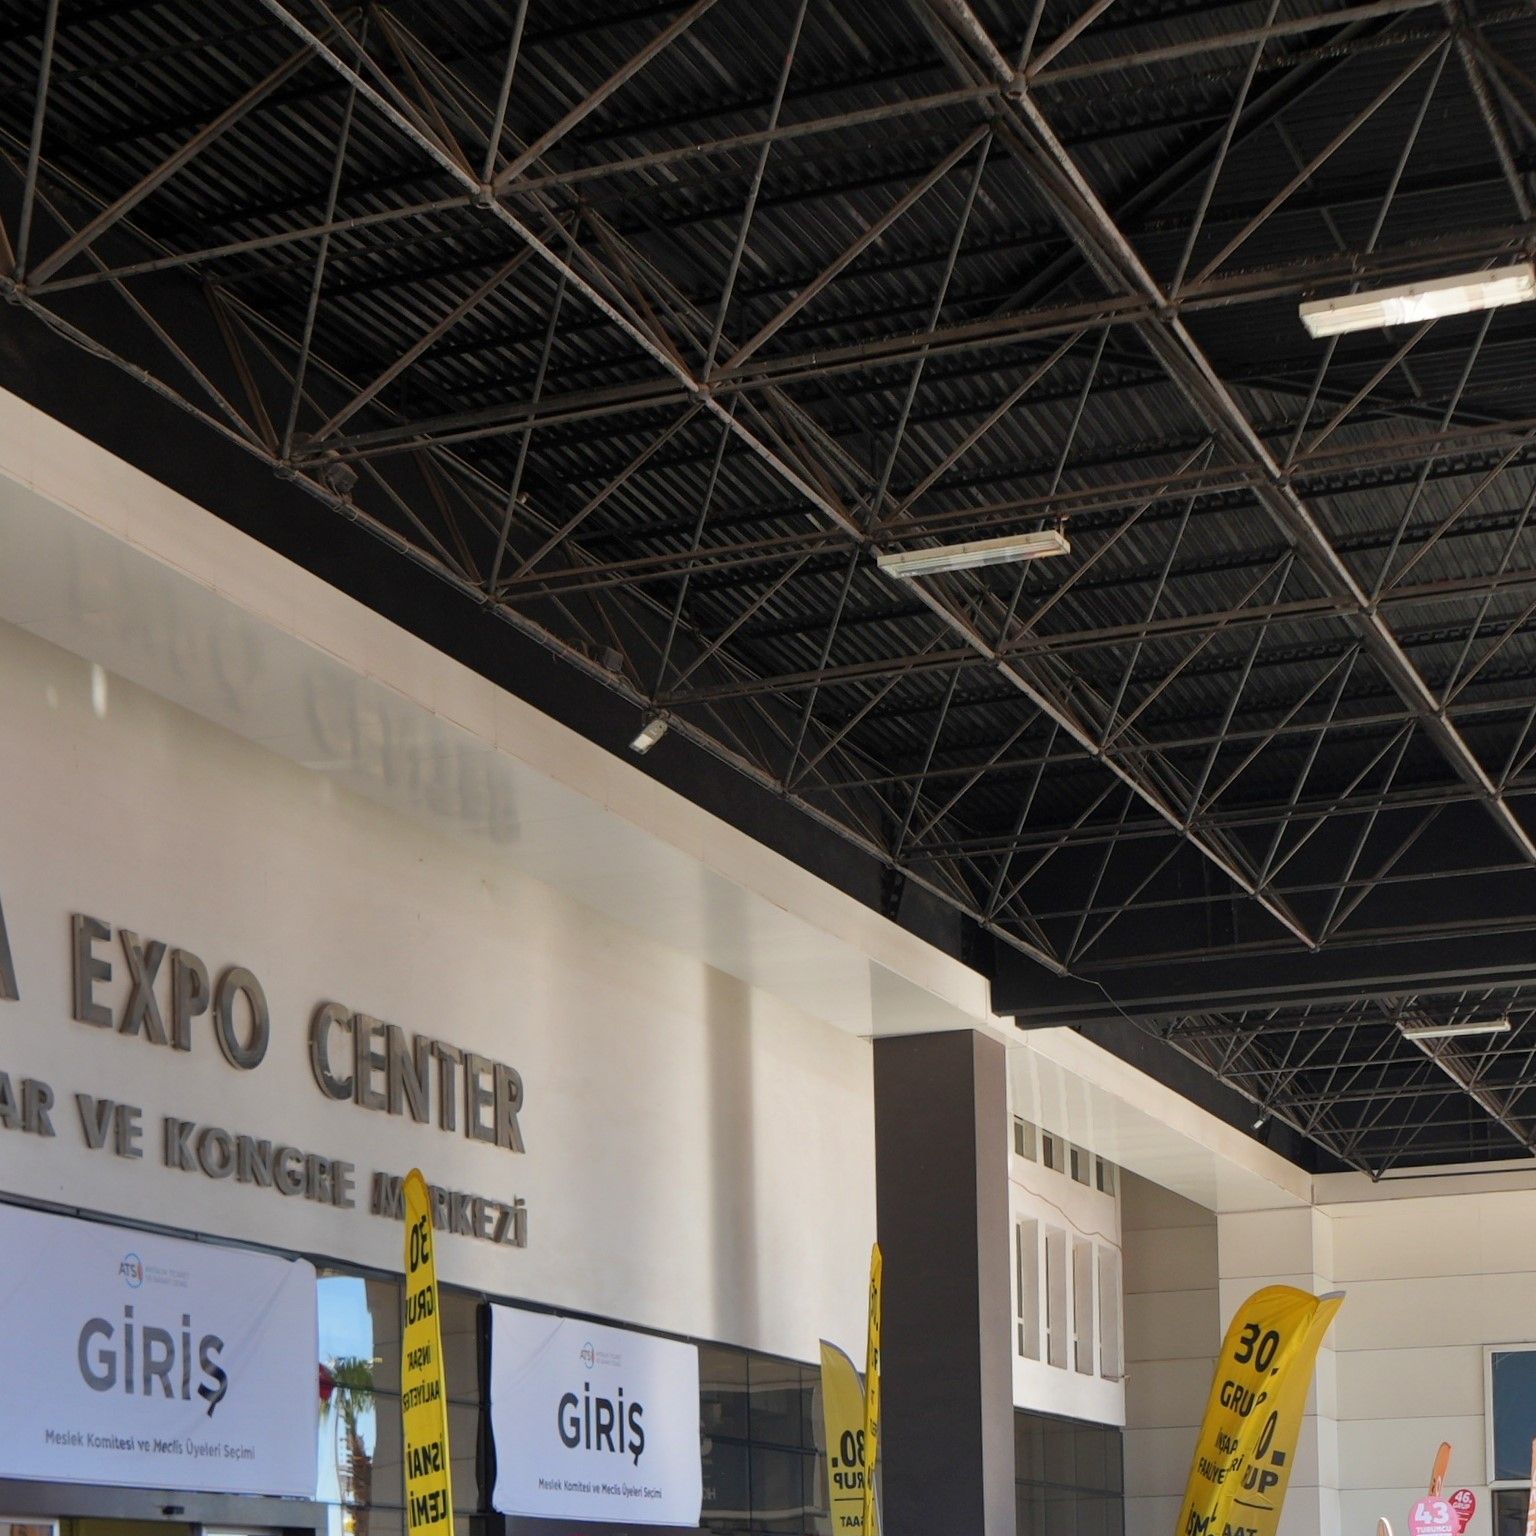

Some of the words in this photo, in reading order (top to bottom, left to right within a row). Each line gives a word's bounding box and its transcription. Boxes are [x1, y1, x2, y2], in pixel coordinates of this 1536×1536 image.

[70, 913, 270, 1070] EXPO
[309, 1001, 525, 1153] CENTER
[75, 1093, 143, 1157] VE
[163, 1116, 355, 1209] KONGRE
[372, 1172, 528, 1247] MRKEZİ
[77, 1304, 228, 1418] GİRİŞ
[1234, 1323, 1280, 1376] 30.
[45, 1429, 84, 1447] Meslek
[87, 1433, 135, 1451] Komitesi
[137, 1440, 150, 1452] ve
[153, 1439, 183, 1455] Meclis
[186, 1438, 221, 1459] Üyeleri
[224, 1444, 256, 1461] Seçimi
[557, 1381, 645, 1467] GİRİŞ
[1254, 1410, 1286, 1466] 0.
[538, 1478, 562, 1491] Meslek
[563, 1479, 591, 1494] Komitesi
[592, 1484, 600, 1494] ve
[601, 1483, 621, 1496] Meclis
[1415, 1501, 1450, 1524] 43
[1416, 1525, 1452, 1534] TURUNCU
